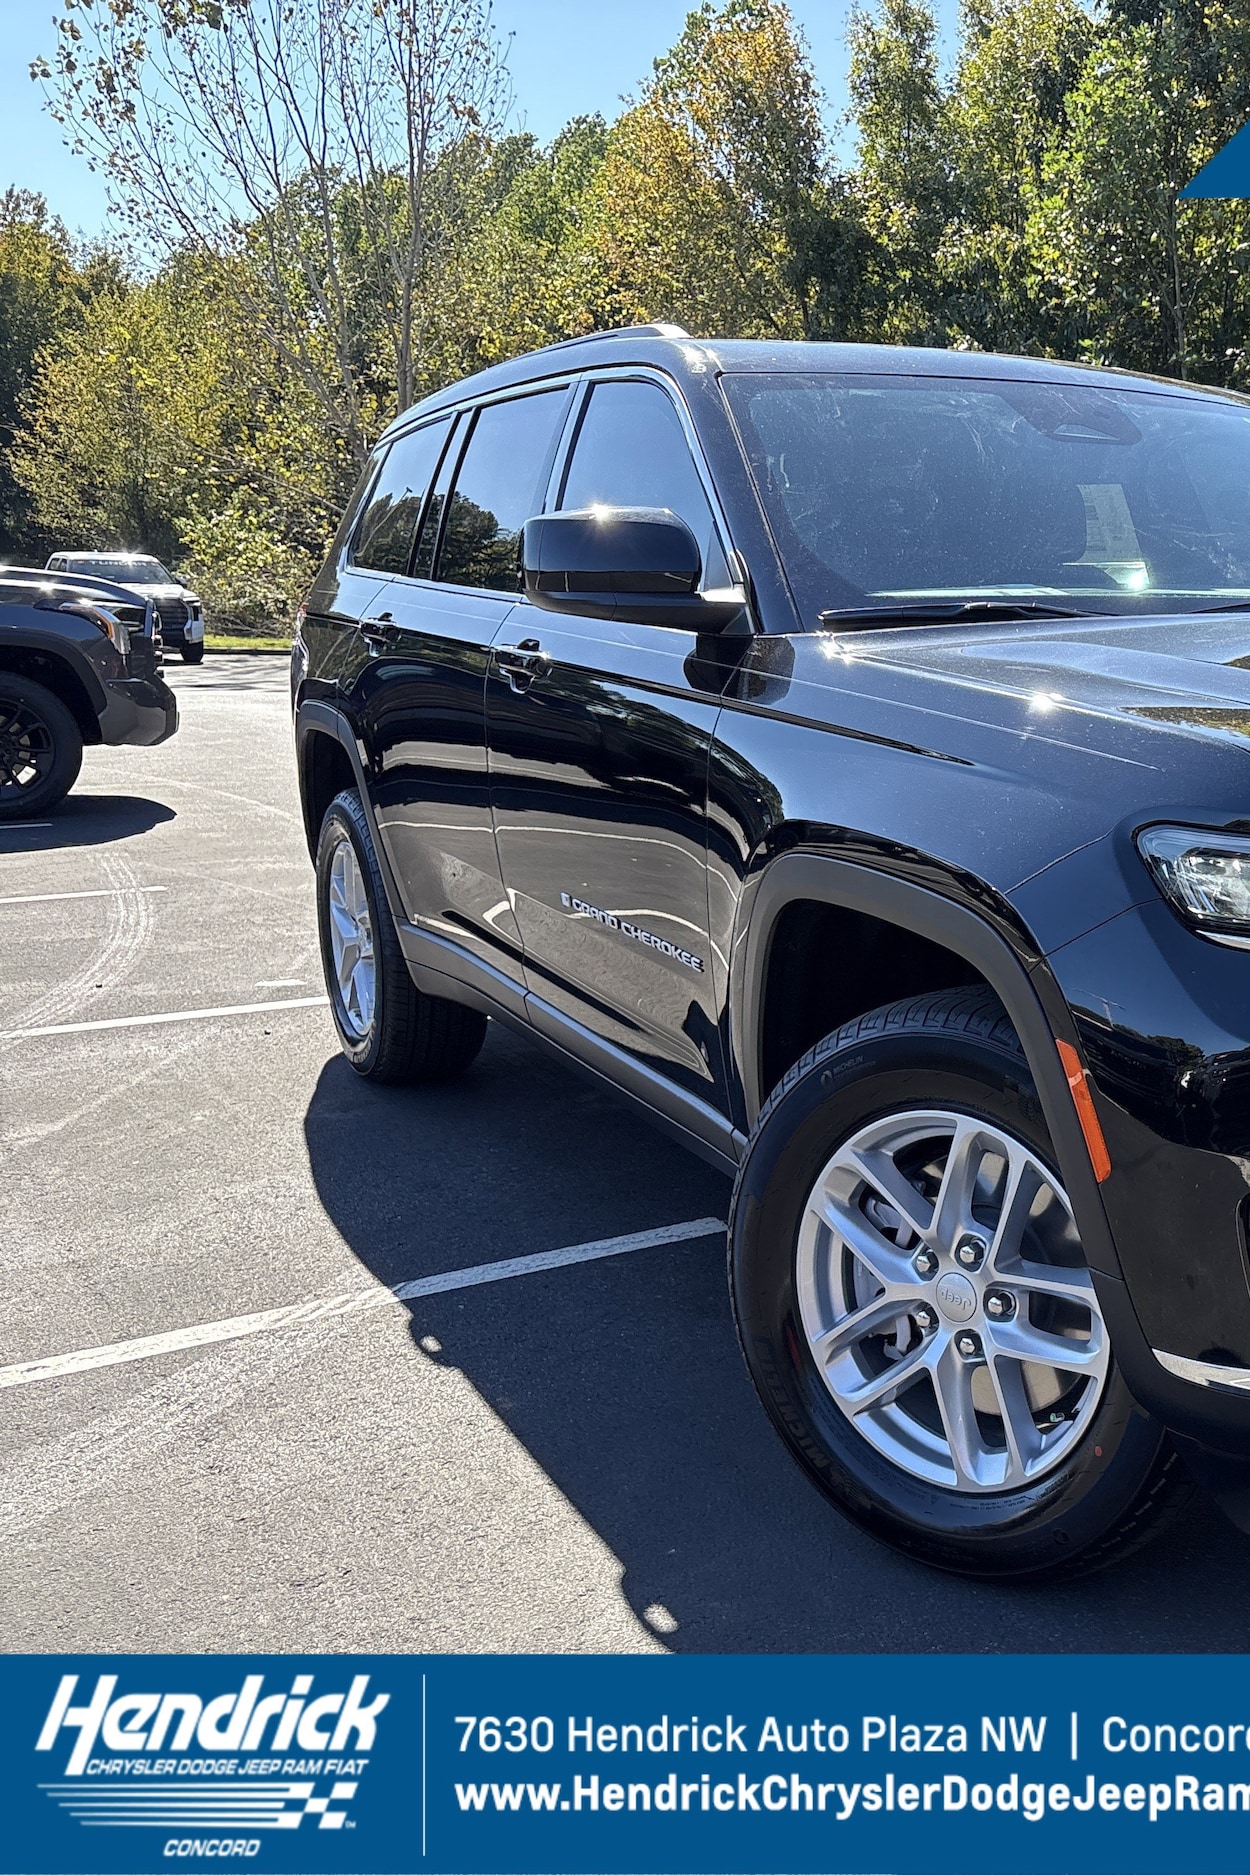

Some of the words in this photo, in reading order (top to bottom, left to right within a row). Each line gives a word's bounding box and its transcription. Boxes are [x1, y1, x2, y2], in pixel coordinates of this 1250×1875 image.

[571, 897, 618, 931] GRAND
[620, 921, 704, 973] CHEROKEE
[941, 1280, 972, 1311] Jeep
